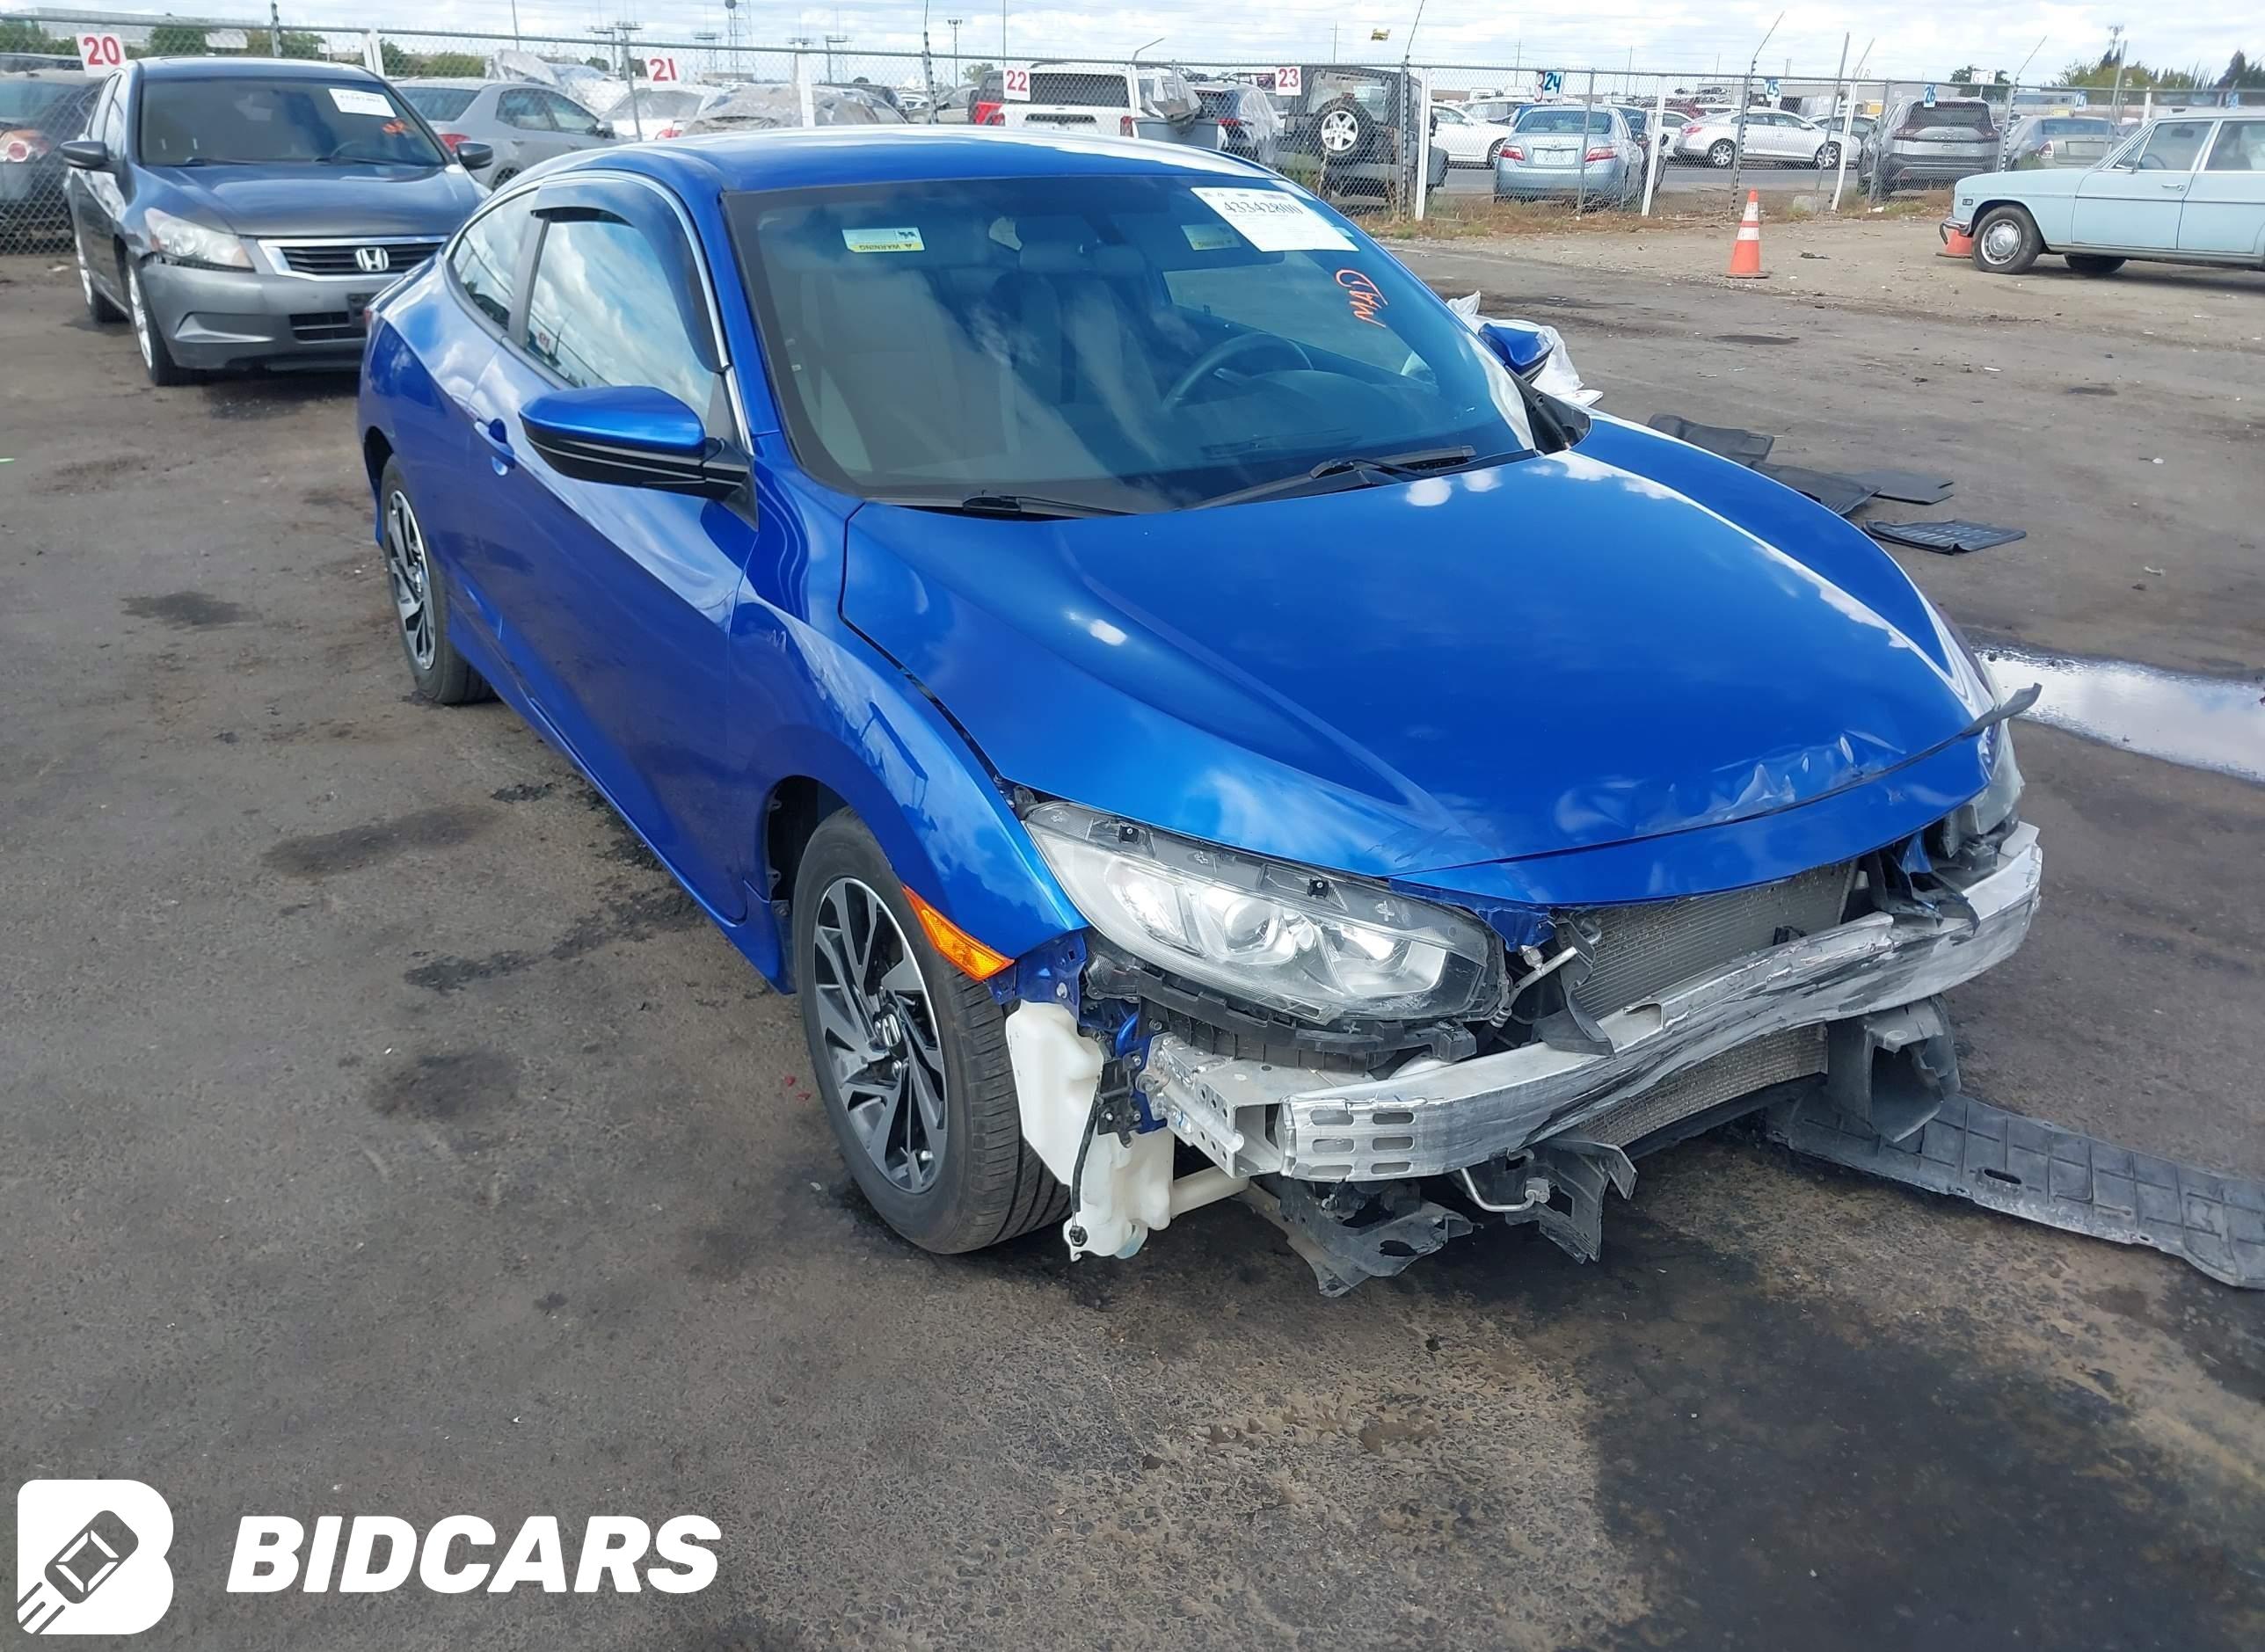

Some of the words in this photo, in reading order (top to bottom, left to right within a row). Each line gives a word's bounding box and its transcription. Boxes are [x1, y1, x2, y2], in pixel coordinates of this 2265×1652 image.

[84, 36, 120, 65] 20
[649, 58, 677, 81] 21
[1278, 68, 1299, 87] 23
[1007, 70, 1027, 91] 22
[1544, 72, 1562, 94] 24
[1766, 80, 1780, 97] 25
[1925, 85, 1936, 104] 26
[858, 243, 901, 251] WARNING
